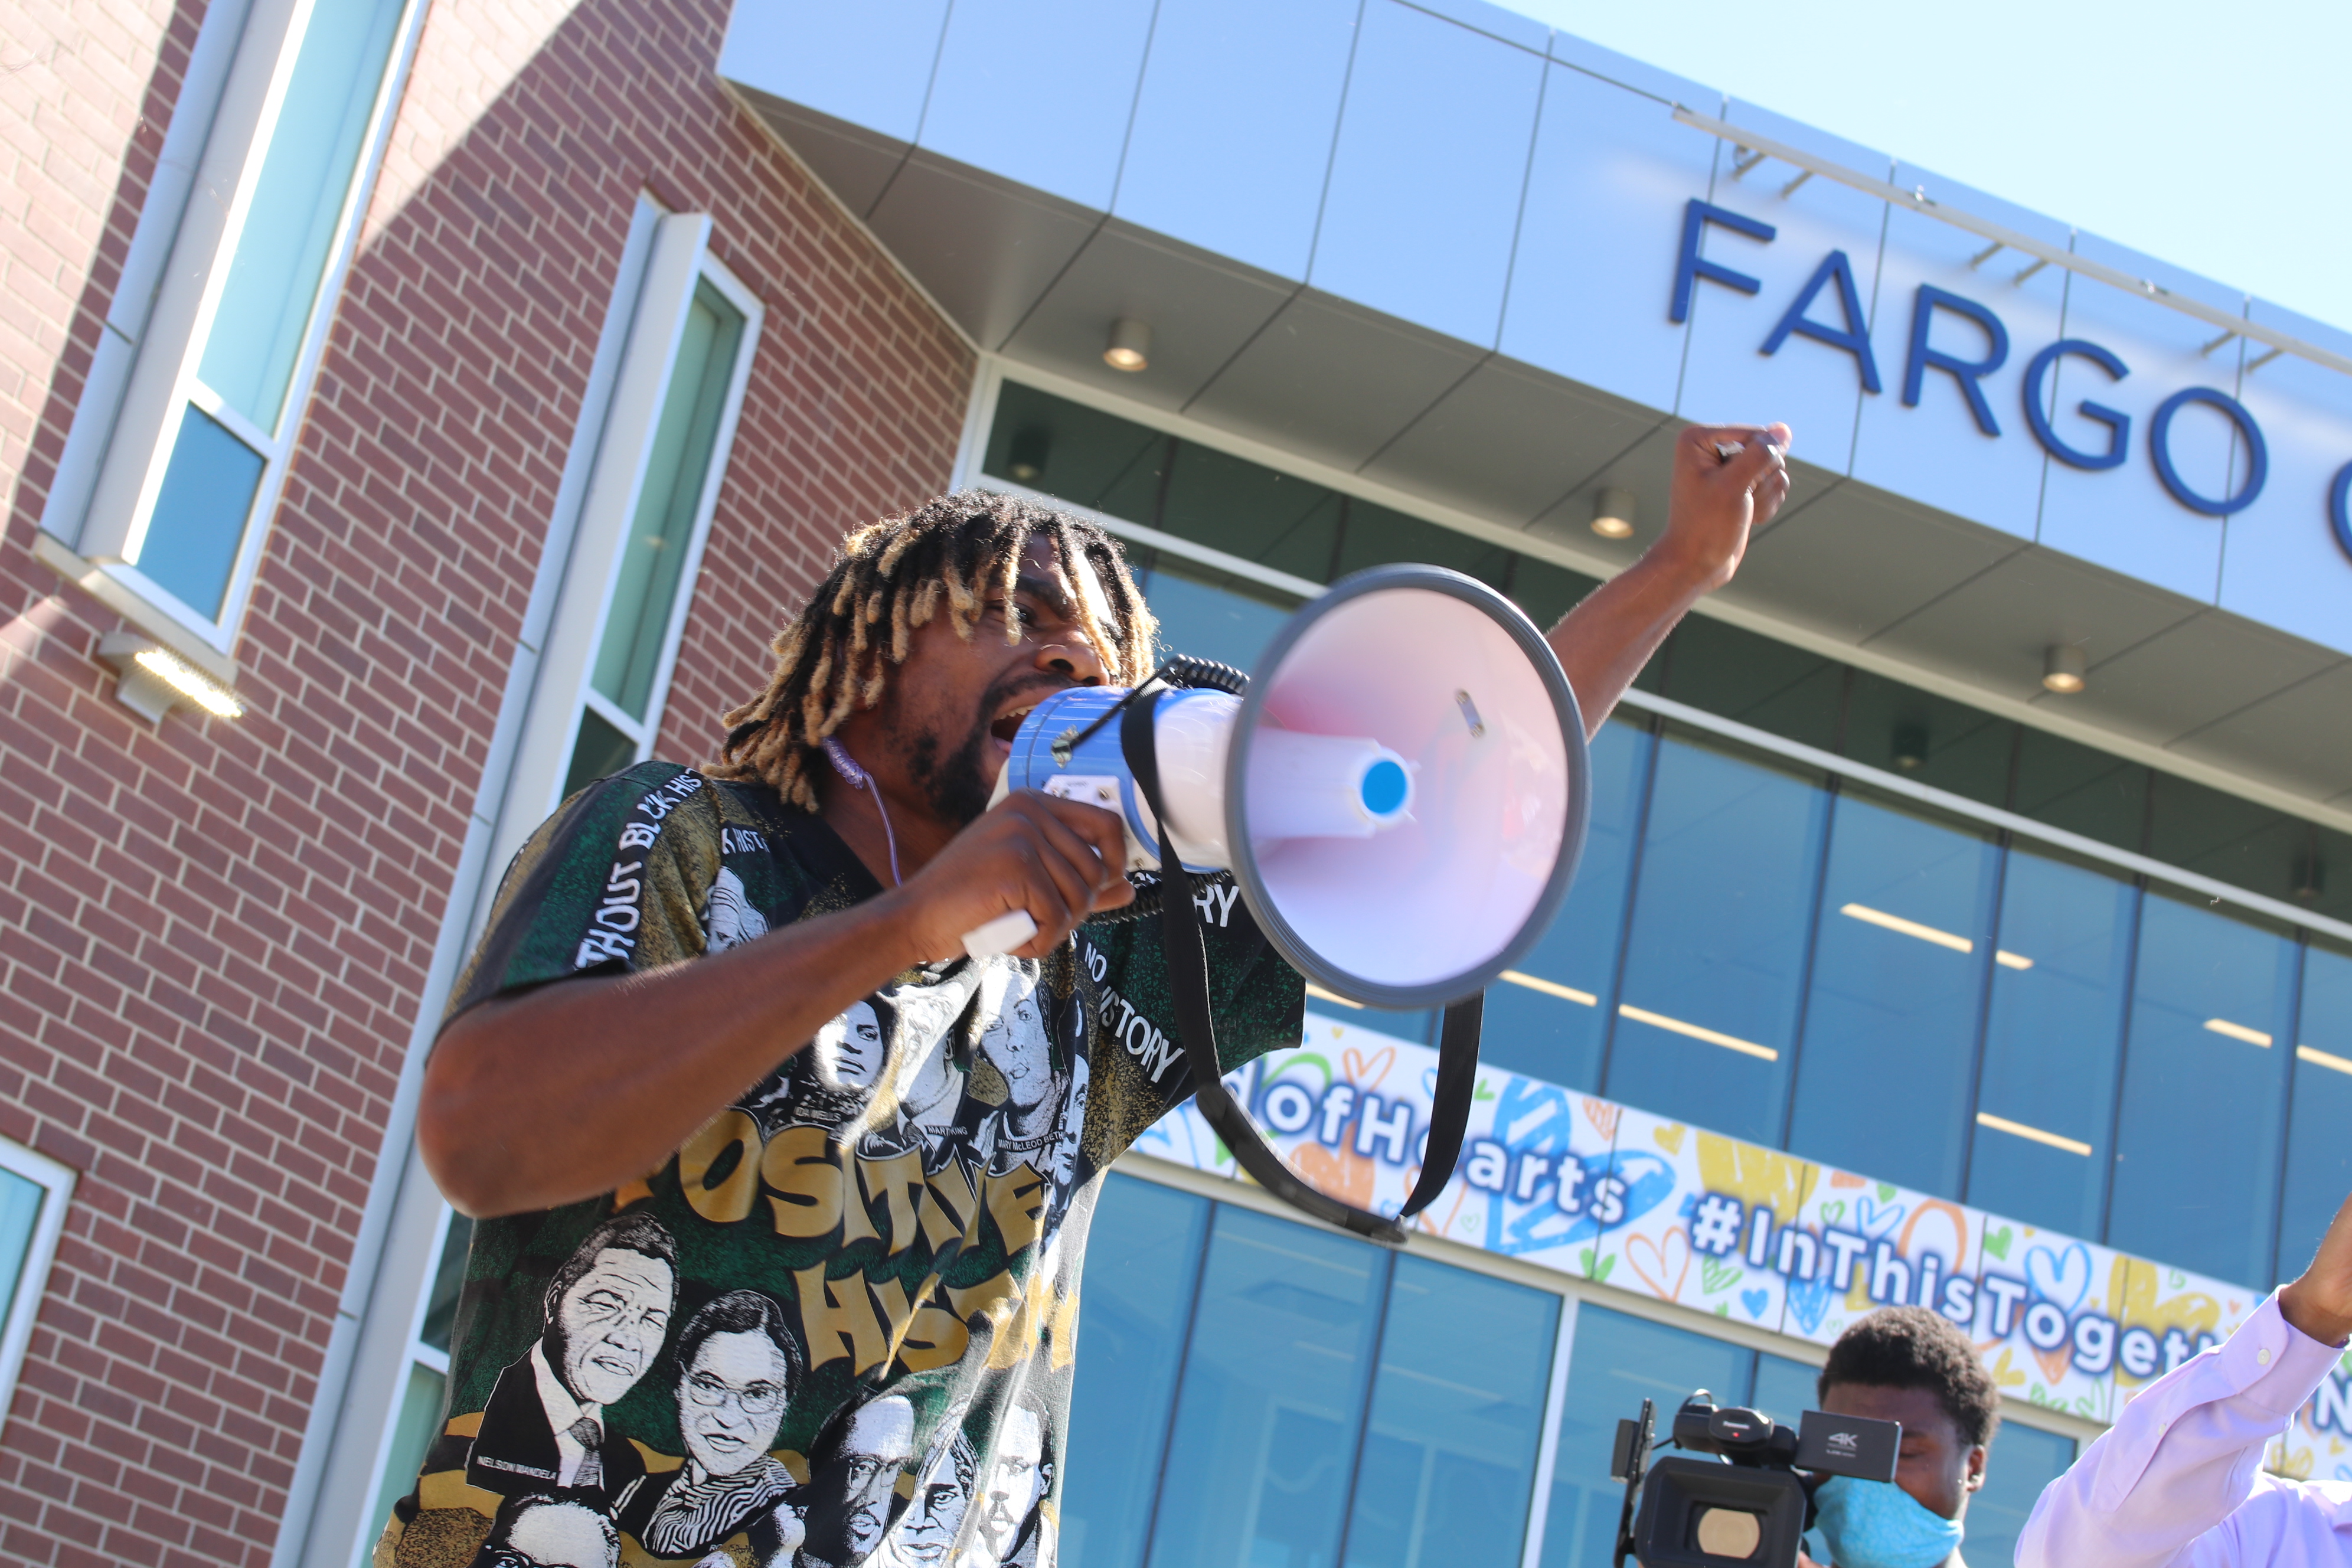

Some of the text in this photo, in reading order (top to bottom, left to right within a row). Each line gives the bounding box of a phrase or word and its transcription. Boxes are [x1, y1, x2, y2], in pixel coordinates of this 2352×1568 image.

[1668, 198, 2269, 518] FARGO
[731, 827, 771, 854] HIST
[1084, 942, 1108, 983] NO
[998, 1138, 1012, 1150] MARY
[1012, 1138, 1043, 1151] McLEOD
[1221, 1057, 1628, 1224] ofHarts
[1828, 1432, 1858, 1448] 4K
[476, 1455, 557, 1480] NELSON MANDELA
